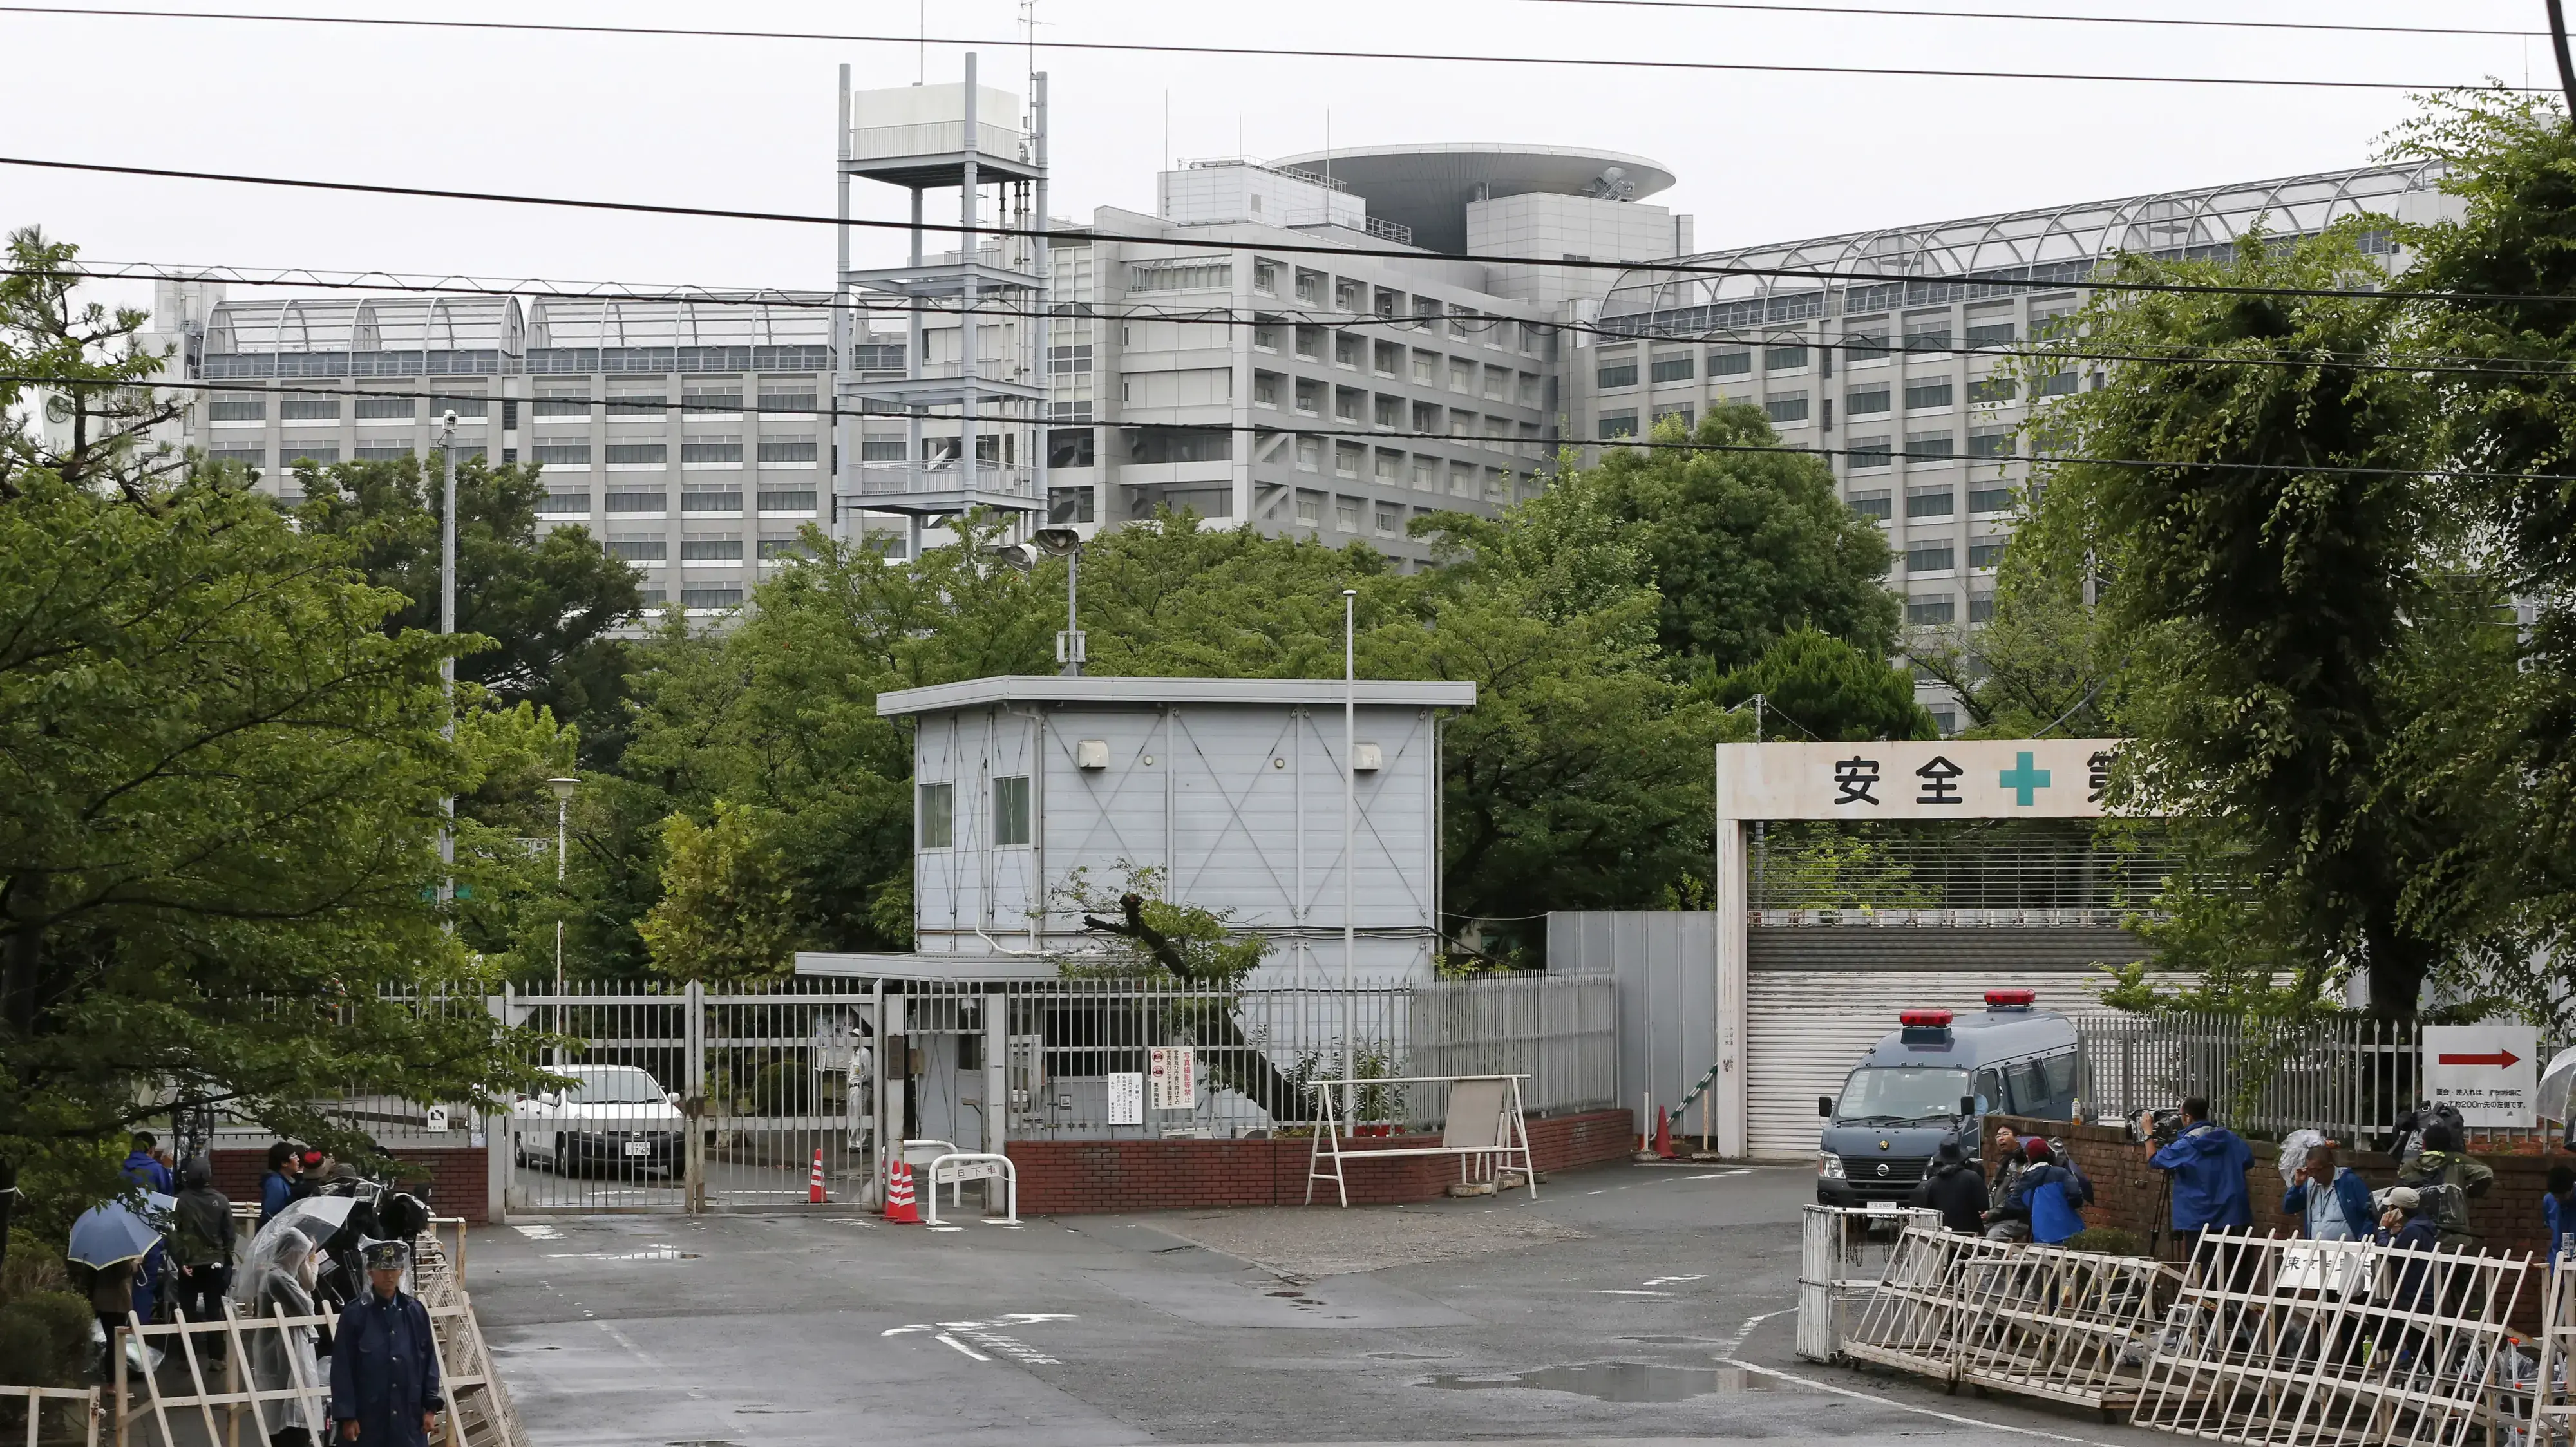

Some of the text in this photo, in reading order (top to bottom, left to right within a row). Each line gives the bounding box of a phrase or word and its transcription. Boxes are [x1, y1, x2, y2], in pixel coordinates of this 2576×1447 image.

[1833, 755, 1964, 806] 安全
[941, 1164, 997, 1179] 一旦下車
